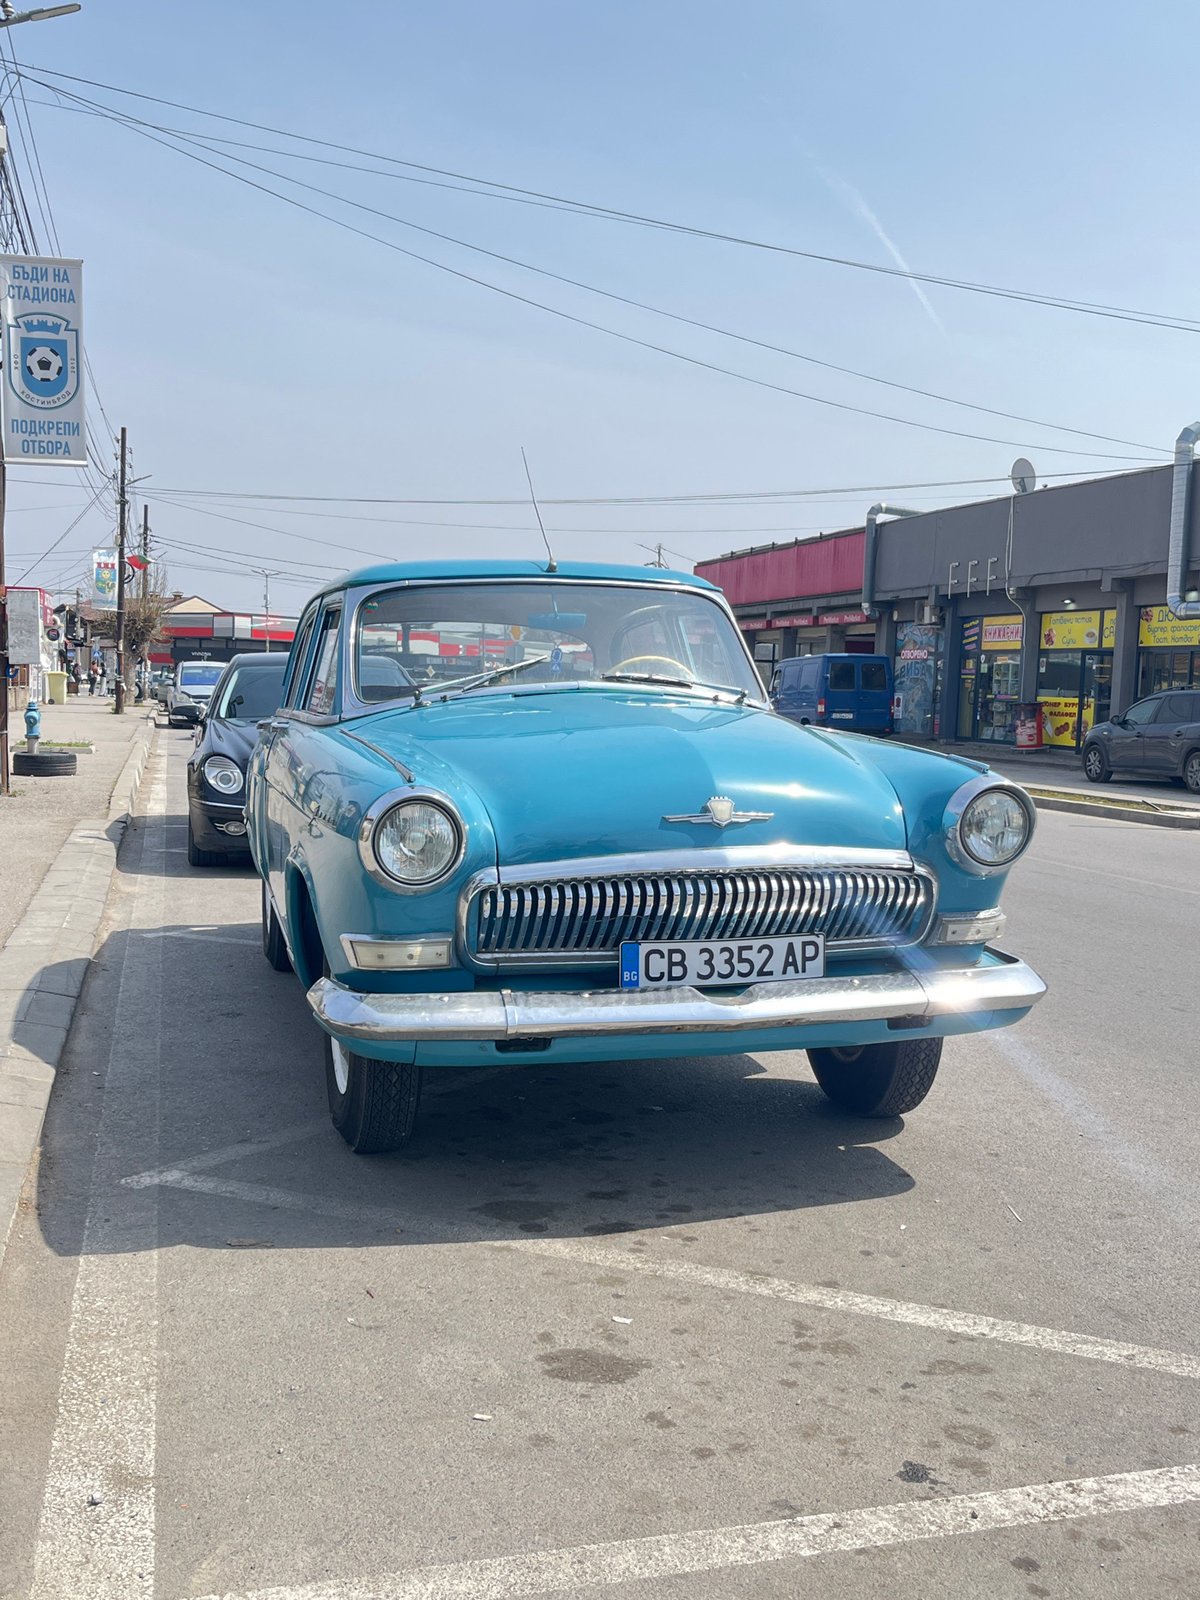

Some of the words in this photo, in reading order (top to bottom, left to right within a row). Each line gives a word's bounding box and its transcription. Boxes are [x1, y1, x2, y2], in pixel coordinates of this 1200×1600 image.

[12, 264, 49, 284] БЪДИ
[53, 267, 70, 284] НА
[7, 284, 76, 304] СТАДИОНА
[20, 389, 72, 406] КОСТИНБРОД
[11, 418, 80, 437] ПОДКРЕПИ
[21, 439, 72, 456] ОТБОРА
[900, 649, 928, 659] ОТВОРЕНО
[644, 948, 688, 982] CB
[696, 944, 774, 981] 3352
[781, 940, 820, 976] AP
[623, 970, 639, 982] BG
